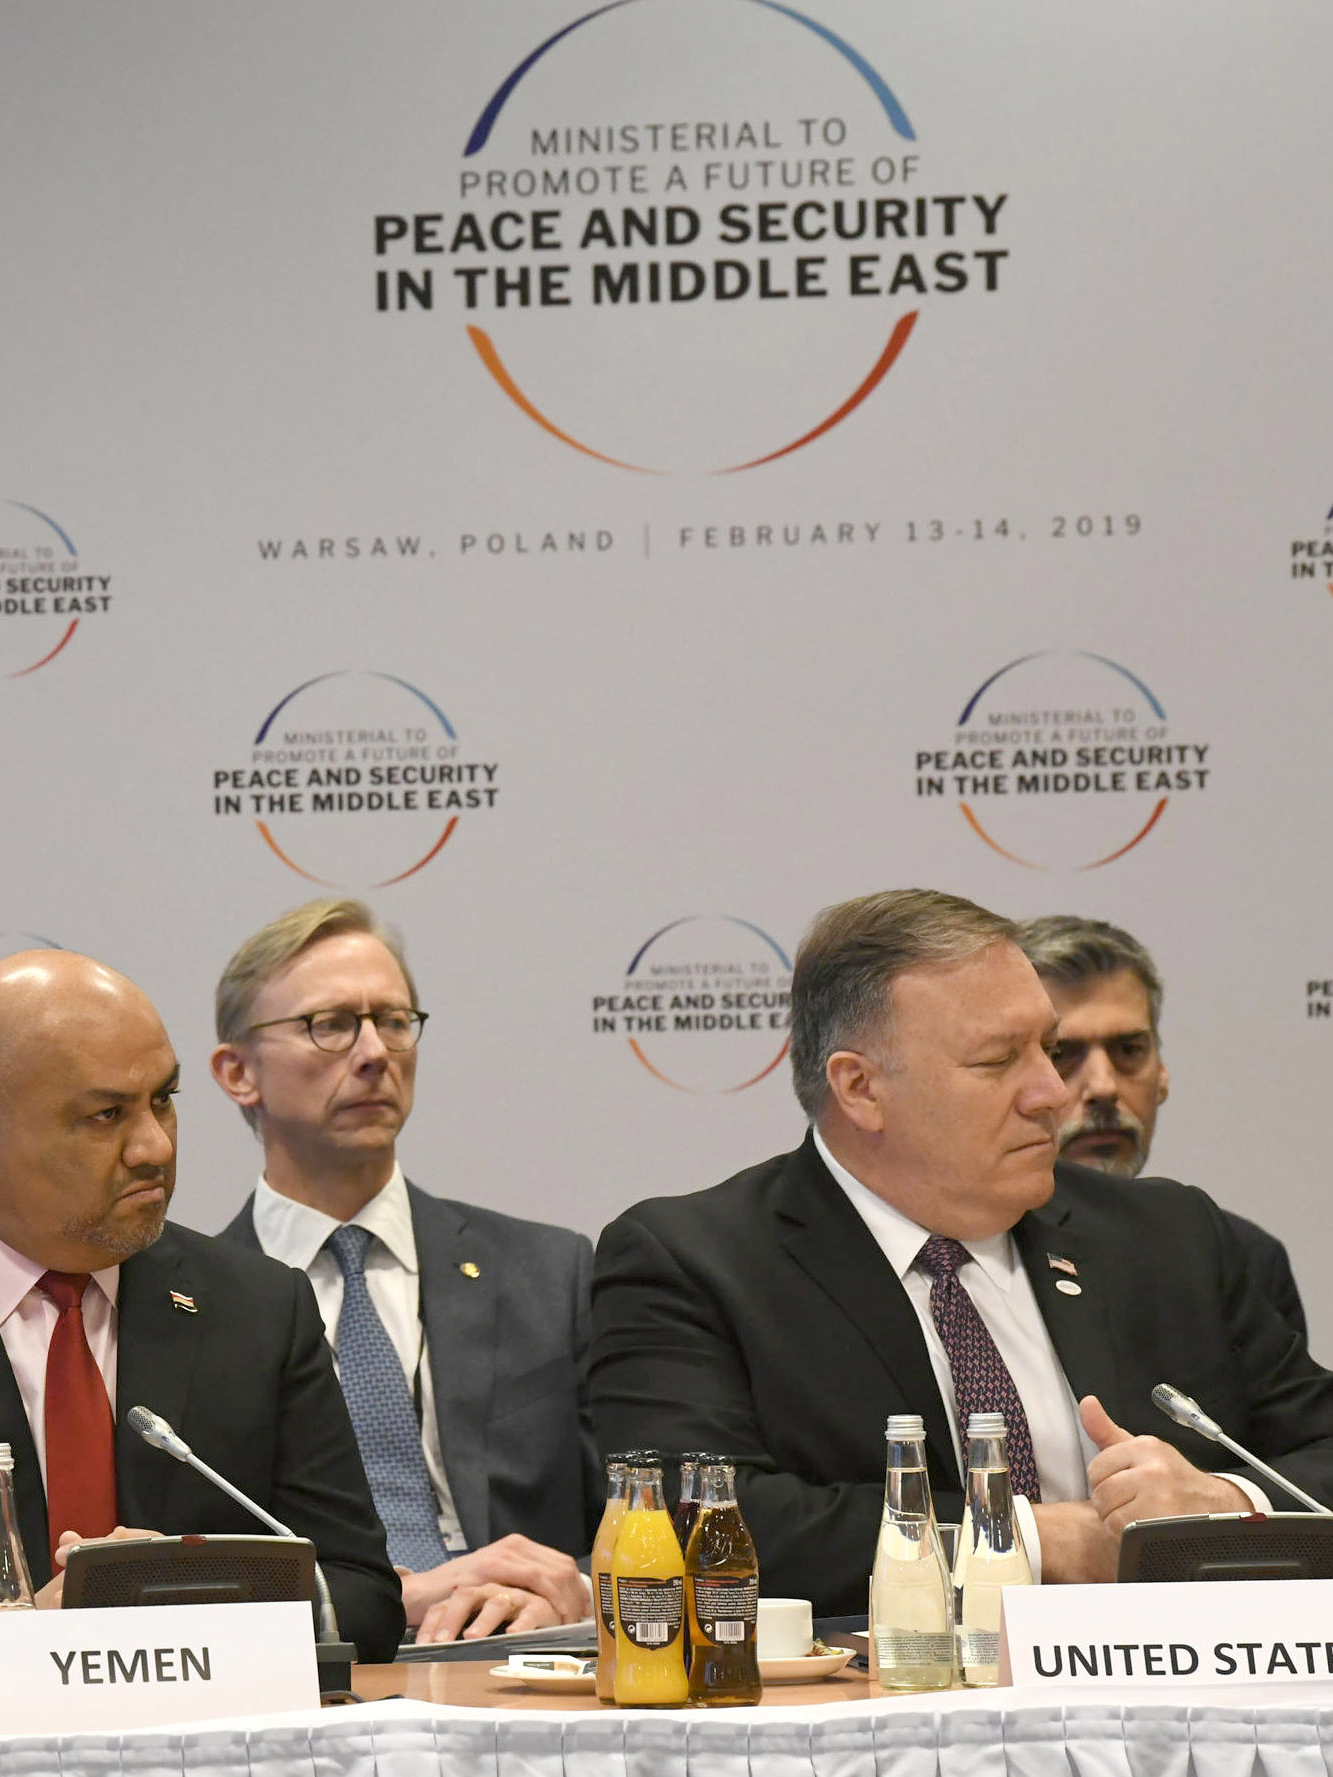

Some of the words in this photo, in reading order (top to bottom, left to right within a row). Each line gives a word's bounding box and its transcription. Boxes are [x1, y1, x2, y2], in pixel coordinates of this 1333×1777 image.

[531, 122, 780, 155] MINISTERIAL
[799, 117, 846, 146] TO
[460, 166, 647, 198] PROMOTE
[665, 165, 687, 191] A
[705, 158, 854, 190] FUTURE
[871, 155, 919, 185] OF
[375, 210, 561, 255] PEACE
[580, 206, 700, 249] AND
[719, 194, 1007, 244] SECURITY
[377, 269, 432, 312] IN
[454, 265, 571, 309] THE
[593, 257, 827, 305] MIDDLE
[850, 250, 1009, 296] EAST
[258, 536, 436, 561] WARSAW,
[461, 530, 616, 555] POLAND
[679, 523, 881, 549] FEBRUARY
[907, 517, 1028, 544] 13-14,
[1051, 513, 1143, 539] 2019
[1291, 540, 1333, 558] PEA
[1291, 562, 1315, 579] IN
[5, 575, 111, 594] SECURITY
[53, 596, 112, 613] EAST
[988, 711, 1104, 726] MINISTERIAL
[1112, 709, 1135, 723] TO
[284, 730, 396, 745] MINISTERIAL
[404, 728, 426, 742] TO
[955, 730, 1043, 745] PROMOTE
[1050, 730, 1061, 742] A
[1069, 727, 1138, 742] FUTURE
[1145, 726, 1168, 740] OF
[252, 749, 337, 764] PROMOTE
[344, 749, 355, 761] A
[362, 746, 430, 761] FUTURE
[437, 745, 459, 759] OF
[916, 750, 1003, 770] PEACE
[1011, 748, 1067, 768] AND
[1075, 744, 1209, 767] SECURITY
[214, 769, 298, 789] PEACE
[306, 767, 361, 787] AND
[369, 763, 498, 785] SECURITY
[917, 776, 943, 796] IN
[953, 775, 1008, 795] THE
[1017, 772, 1126, 794] MIDDLE
[1136, 769, 1210, 790] EAST
[215, 795, 241, 814] IN
[250, 793, 303, 813] THE
[312, 790, 418, 812] MIDDLE
[427, 788, 499, 809] EAST
[593, 995, 663, 1012] PEACE
[669, 994, 714, 1010] AND
[721, 991, 792, 1009] SECUR
[1307, 1001, 1331, 1018] IN
[594, 1016, 615, 1033] IN
[622, 1015, 667, 1032] THE
[674, 1013, 762, 1031] MIDDLE
[49, 1646, 212, 1685] YEMEN
[1032, 1643, 1200, 1678] UNITED
[1213, 1642, 1333, 1676] STAT
